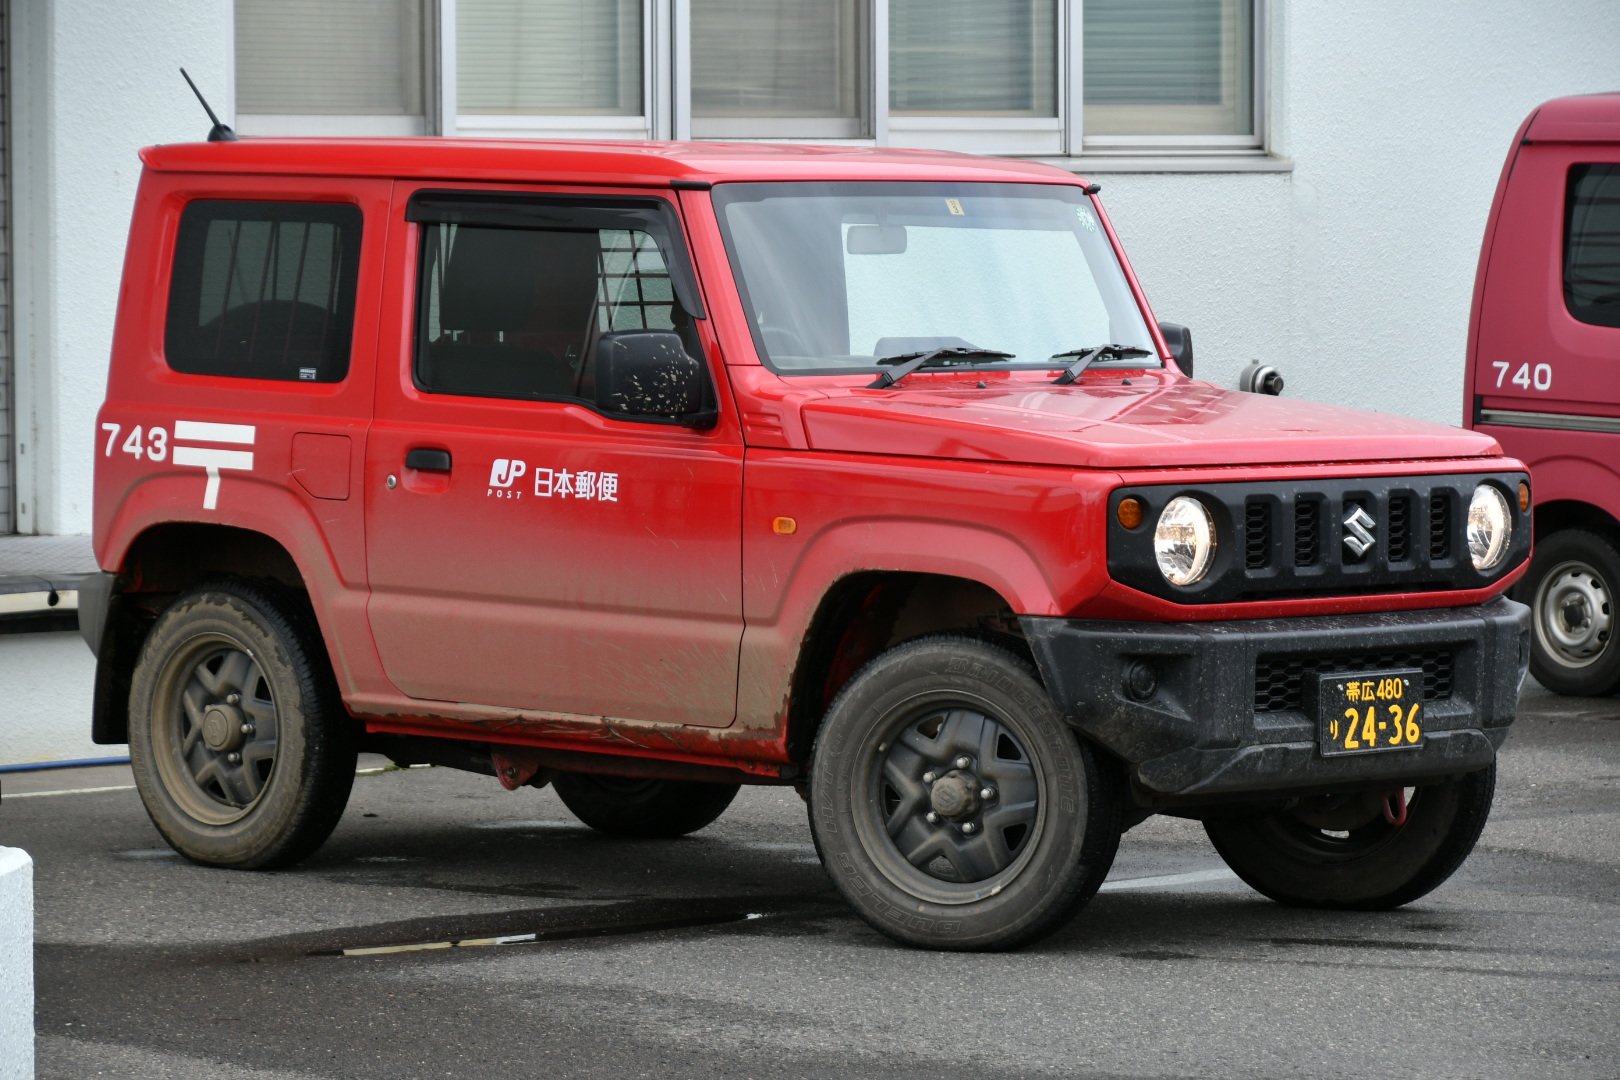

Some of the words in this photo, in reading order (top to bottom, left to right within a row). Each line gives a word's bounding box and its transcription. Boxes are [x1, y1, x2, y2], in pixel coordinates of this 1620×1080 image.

[1492, 361, 1552, 391] 740
[101, 422, 168, 462] 743
[489, 458, 527, 488] JP
[534, 467, 619, 502] 日本郵便
[487, 488, 522, 500] POST
[1344, 703, 1420, 750] 24-36
